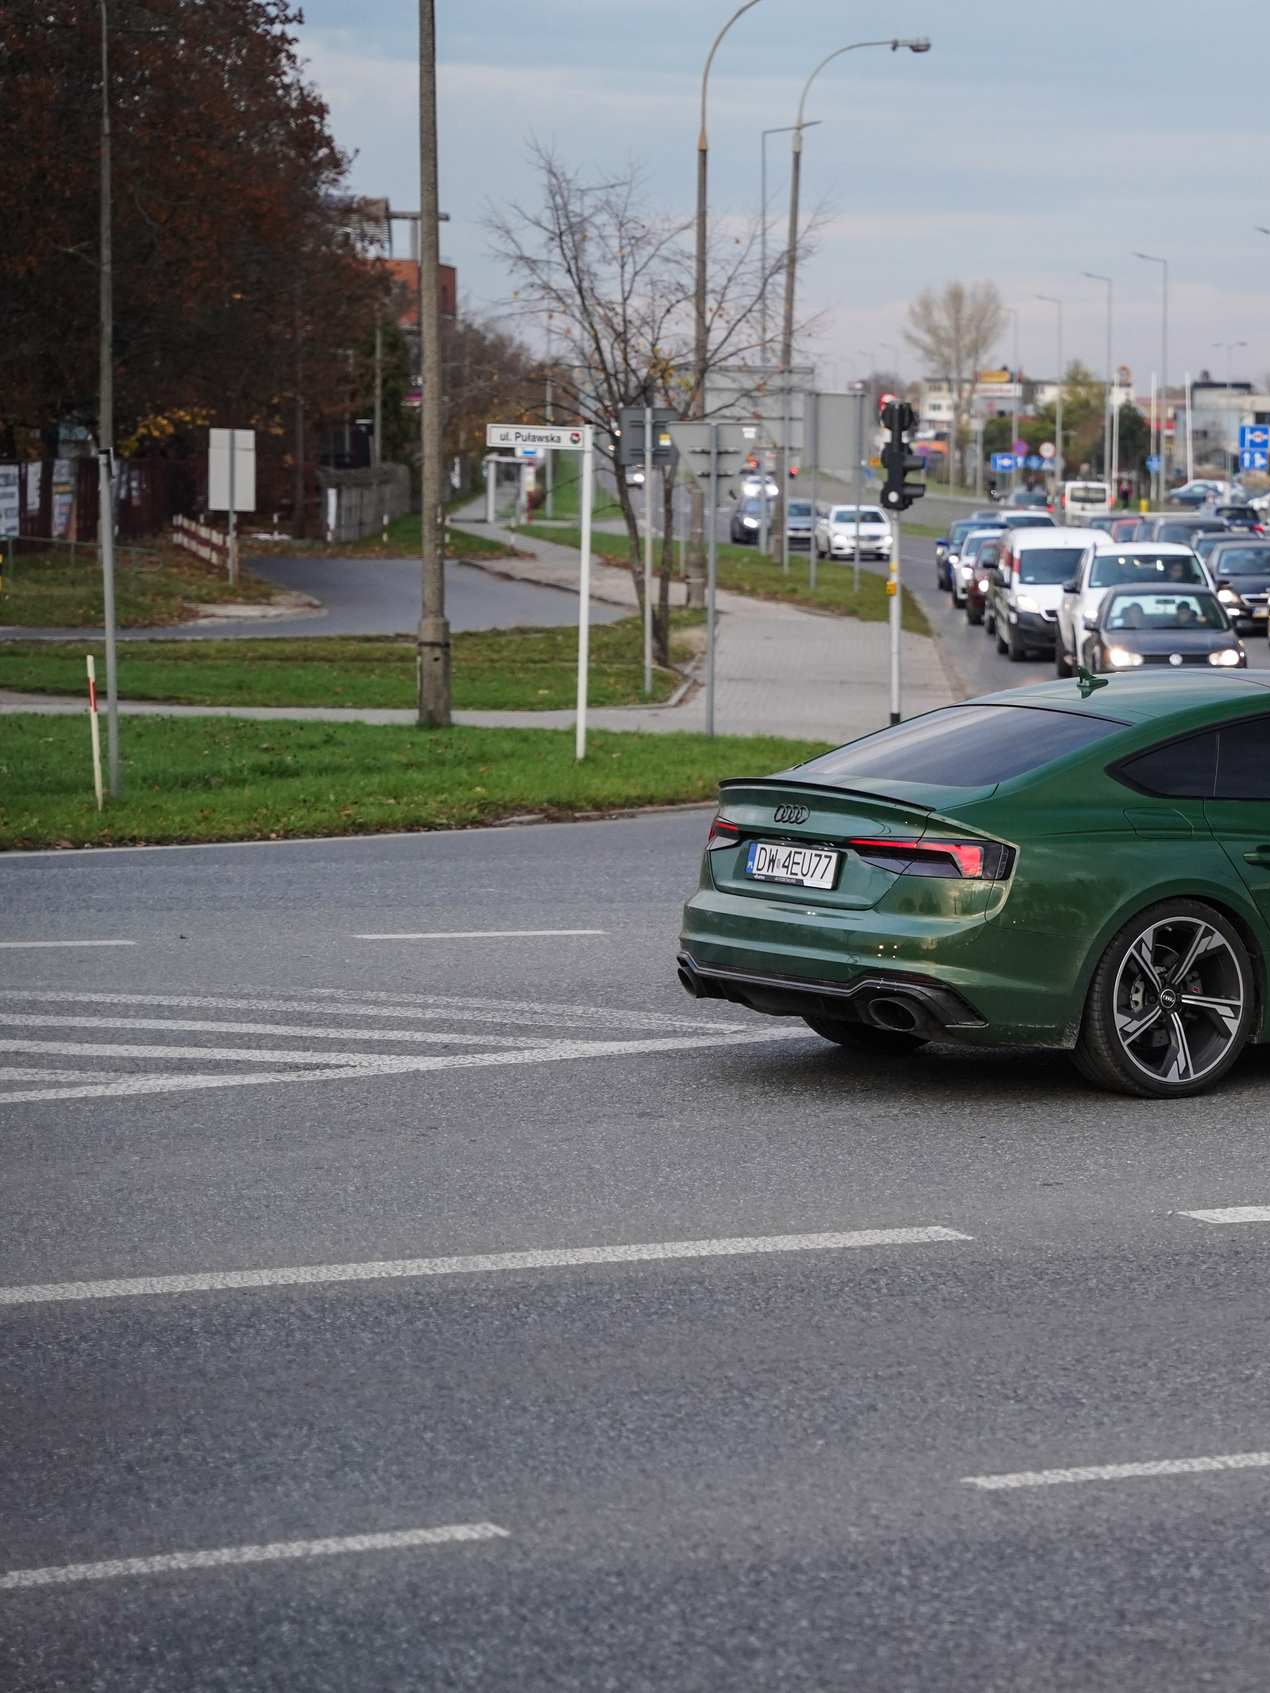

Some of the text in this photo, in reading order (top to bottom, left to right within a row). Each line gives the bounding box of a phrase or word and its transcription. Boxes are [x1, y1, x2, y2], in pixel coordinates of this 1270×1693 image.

[499, 431, 562, 443] ul. Puławska
[756, 846, 833, 880] DW 4EU77
